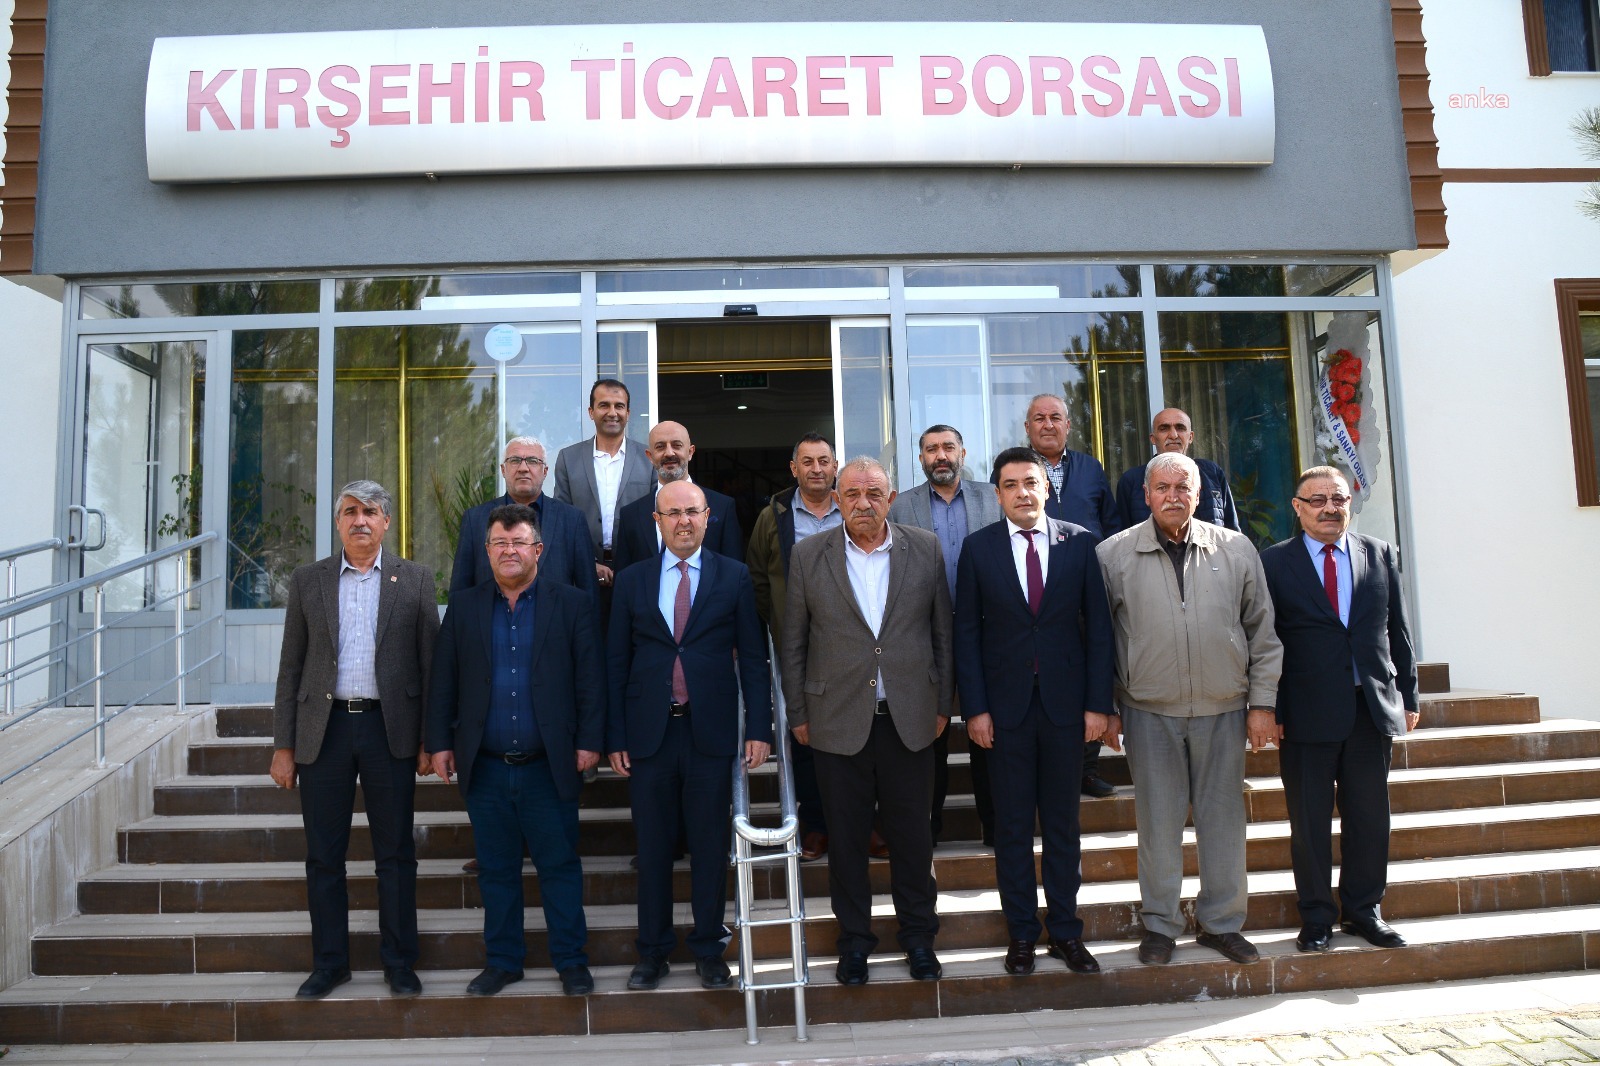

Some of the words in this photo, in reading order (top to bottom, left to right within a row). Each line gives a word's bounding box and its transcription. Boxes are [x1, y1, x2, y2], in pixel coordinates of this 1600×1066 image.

[187, 45, 546, 149] KIRŞEHİR
[571, 42, 894, 121] TİCARET
[919, 54, 1243, 118] BORSASI
[1332, 422, 1341, 432] &
[1336, 430, 1357, 463] SANAYİ
[1353, 461, 1367, 489] ODASI
